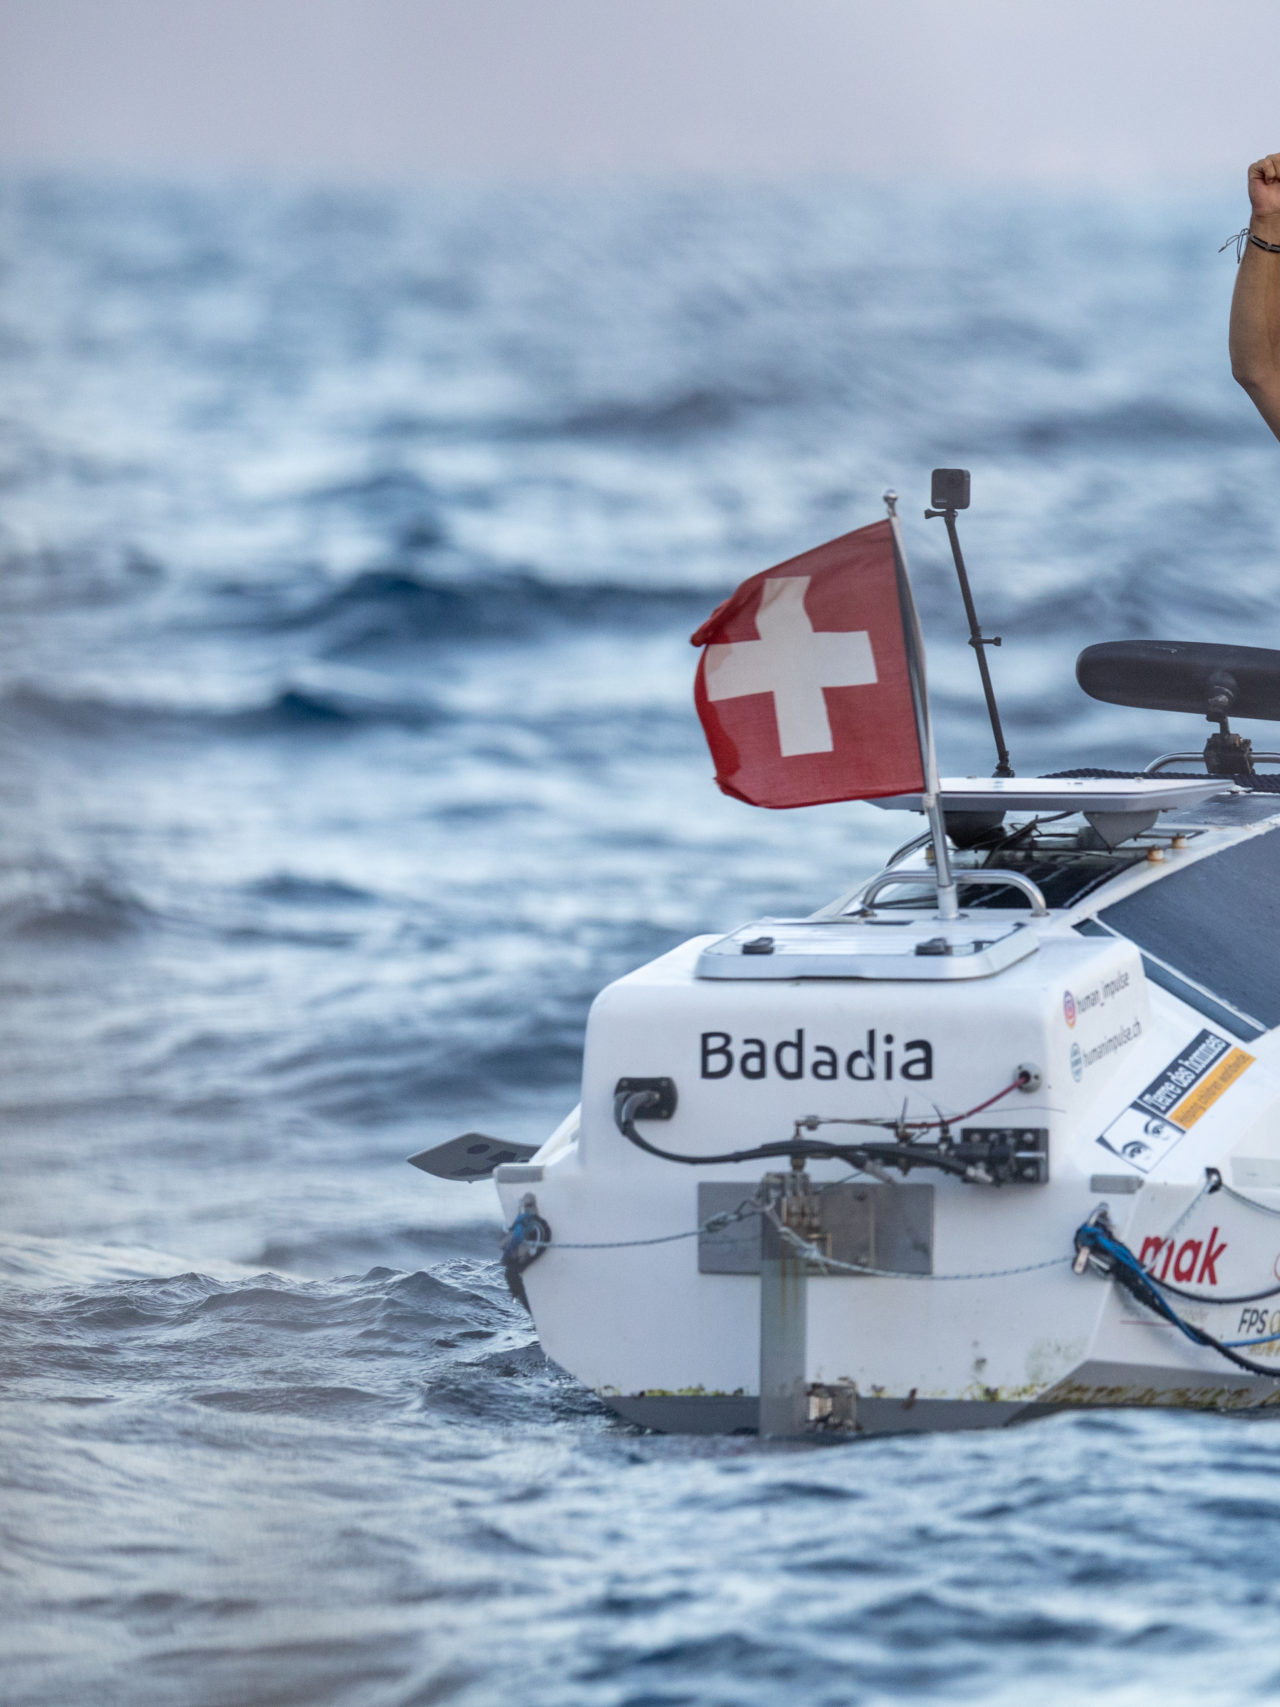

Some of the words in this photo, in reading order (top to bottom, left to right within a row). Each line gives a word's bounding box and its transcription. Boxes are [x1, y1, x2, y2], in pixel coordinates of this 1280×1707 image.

[1076, 970, 1130, 1014] human_impulse
[700, 1028, 933, 1081] Badadia
[1082, 1016, 1143, 1068] humanimpulse.ch
[1178, 1034, 1227, 1073] hommes
[1143, 1080, 1182, 1112] Terre
[1166, 1062, 1197, 1089] des
[1138, 1226, 1227, 1286] mak
[1237, 1307, 1269, 1334] FPS
